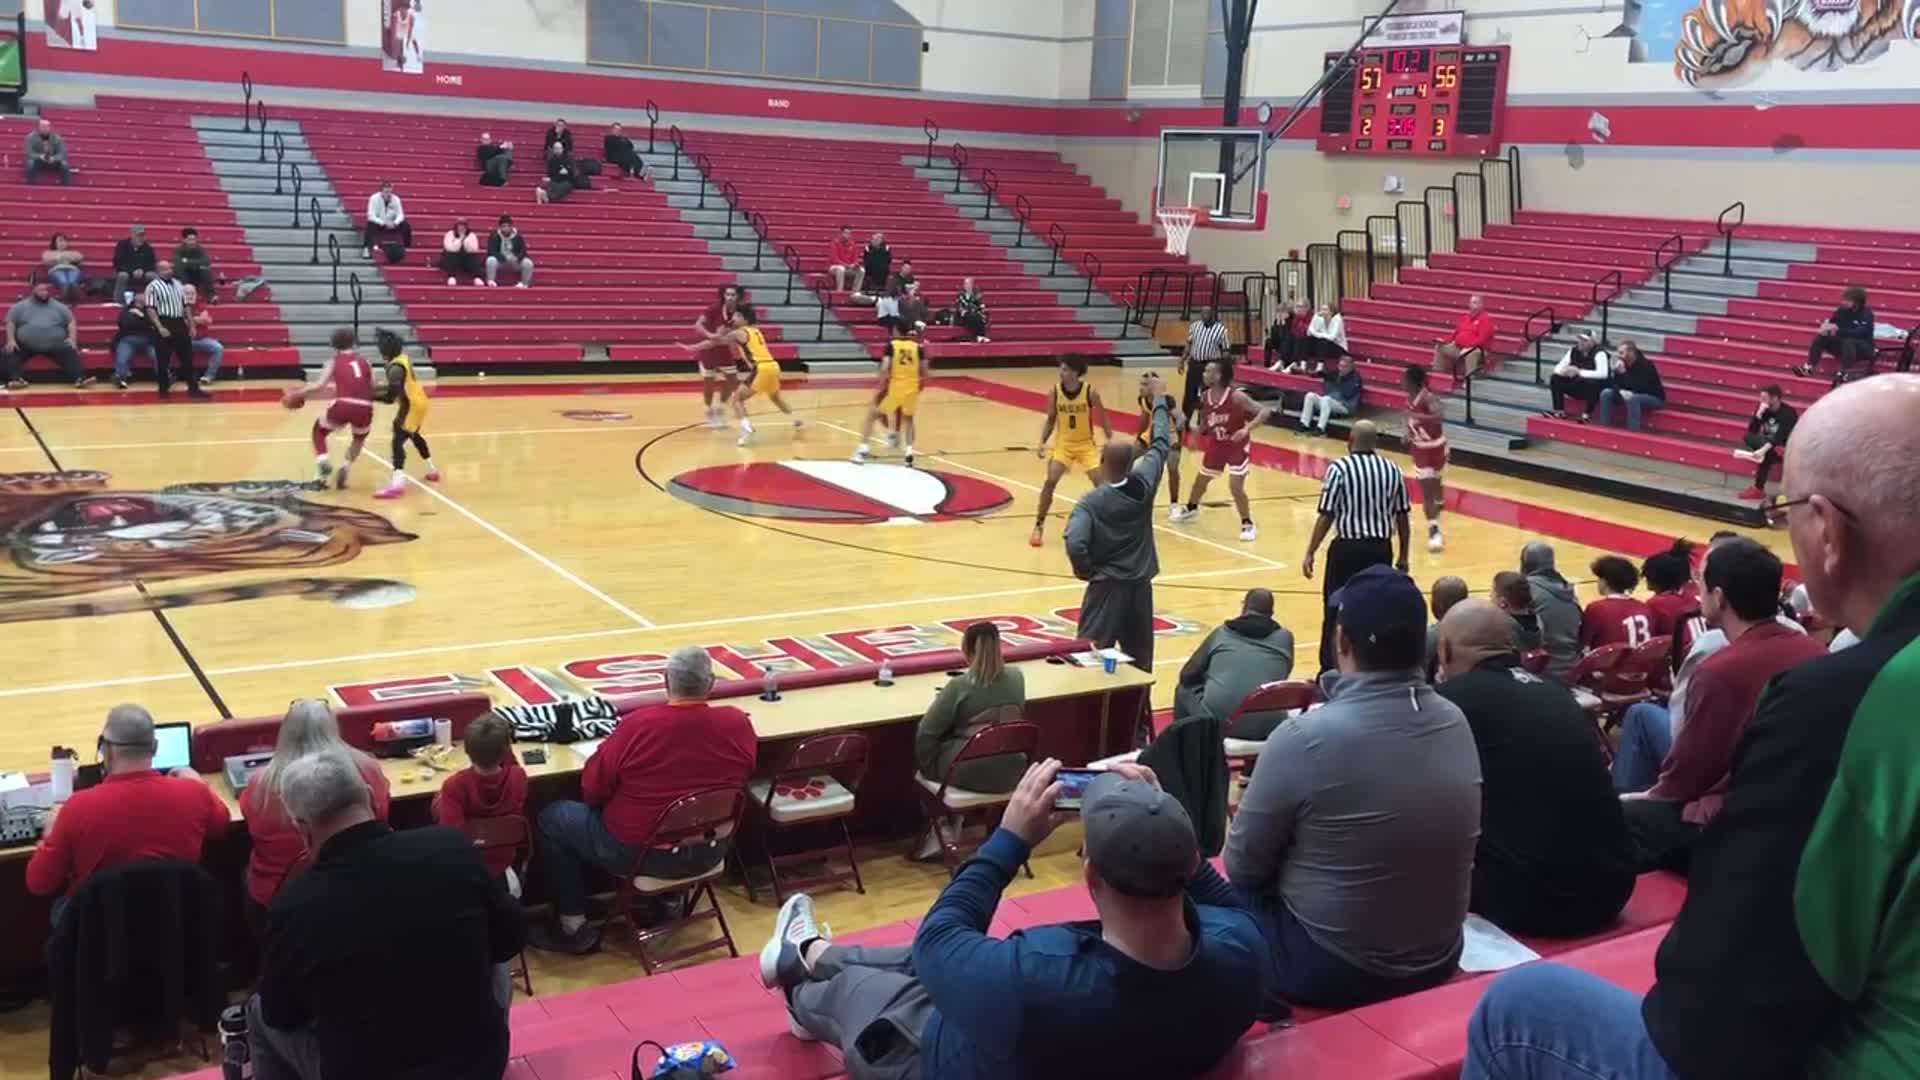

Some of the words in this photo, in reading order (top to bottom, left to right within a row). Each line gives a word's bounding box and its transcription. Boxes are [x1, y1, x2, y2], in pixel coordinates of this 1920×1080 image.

[435, 74, 463, 86] HOME
[1361, 67, 1382, 90] 57
[1419, 84, 1428, 97] 4
[767, 98, 791, 109] BAND
[1362, 119, 1372, 135] 2
[1435, 119, 1445, 135] 3
[349, 360, 362, 378] 1
[1621, 614, 1651, 649] 13
